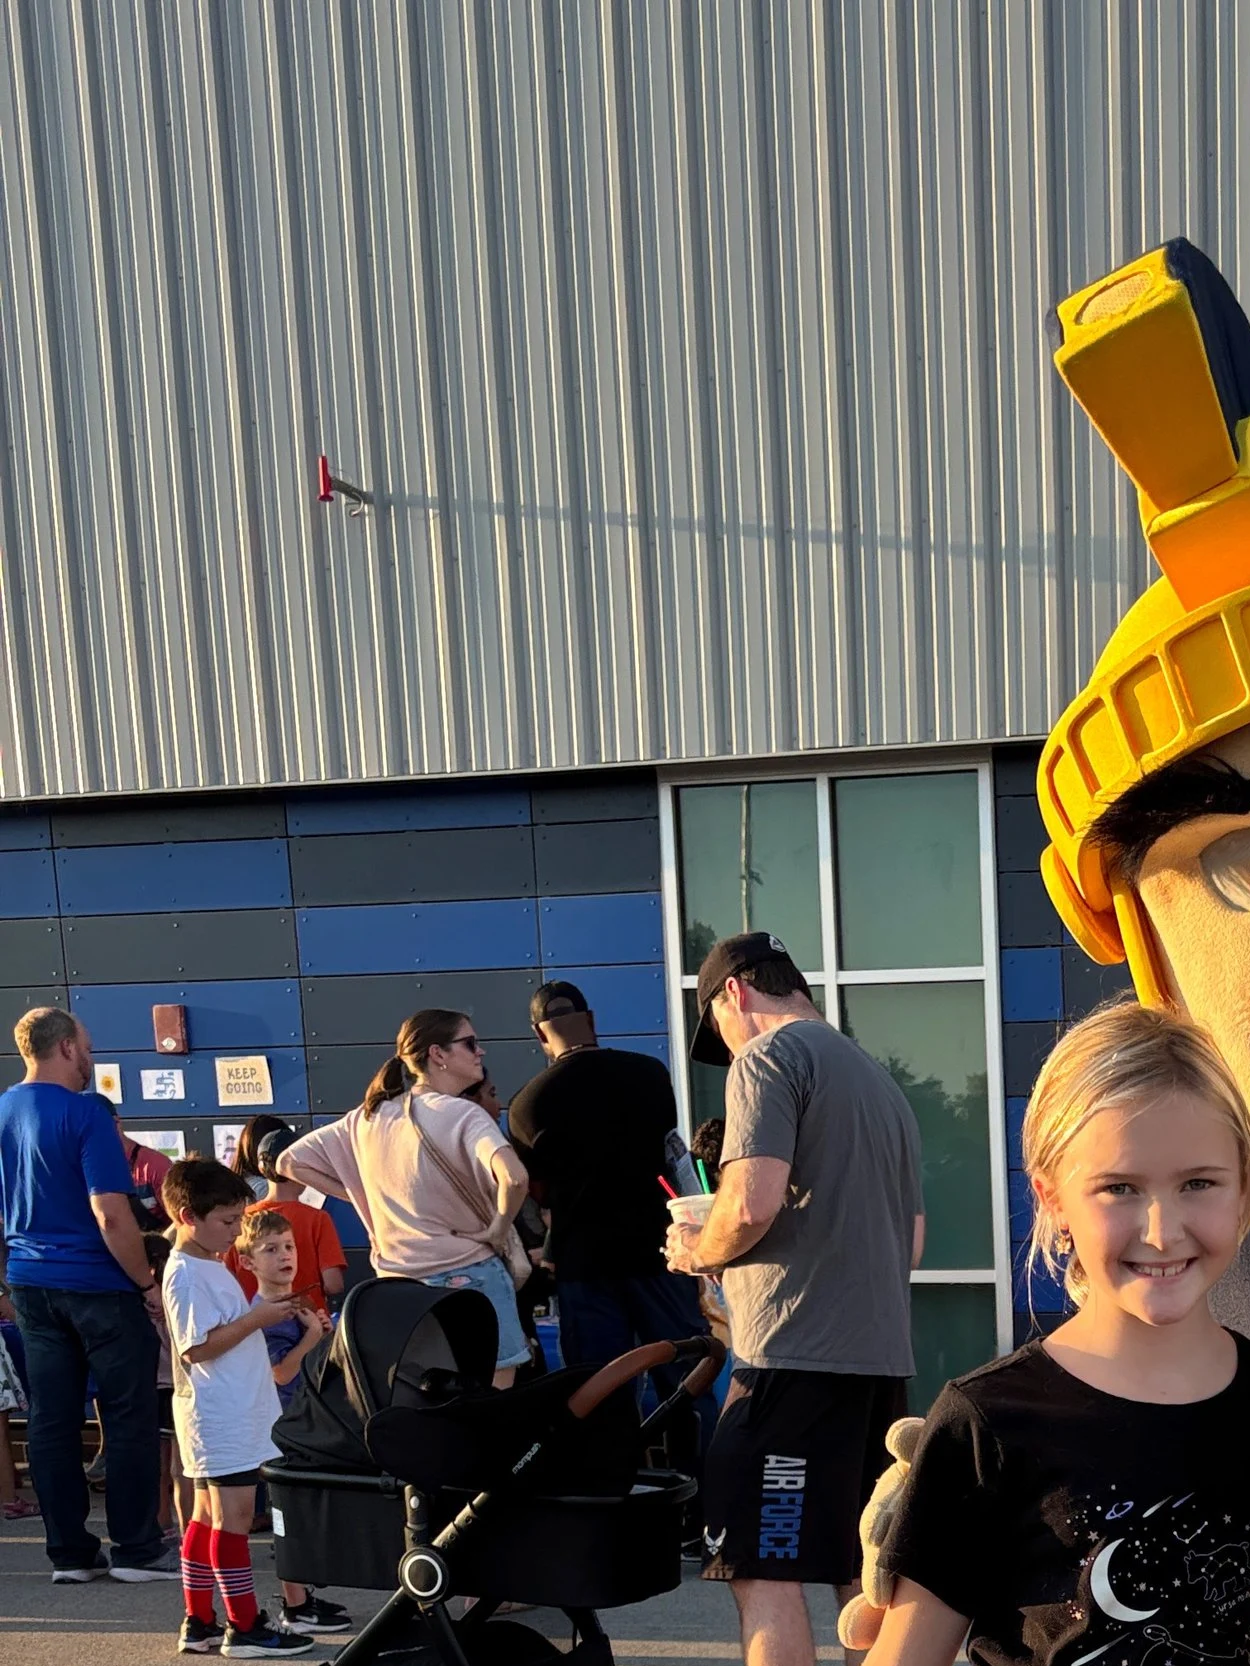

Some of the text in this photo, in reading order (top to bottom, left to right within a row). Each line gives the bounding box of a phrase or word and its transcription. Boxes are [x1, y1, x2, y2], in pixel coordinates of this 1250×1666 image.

[228, 1067, 257, 1080] KEEP
[226, 1082, 263, 1094] GOING
[759, 1454, 807, 1560] AIR FORCE
